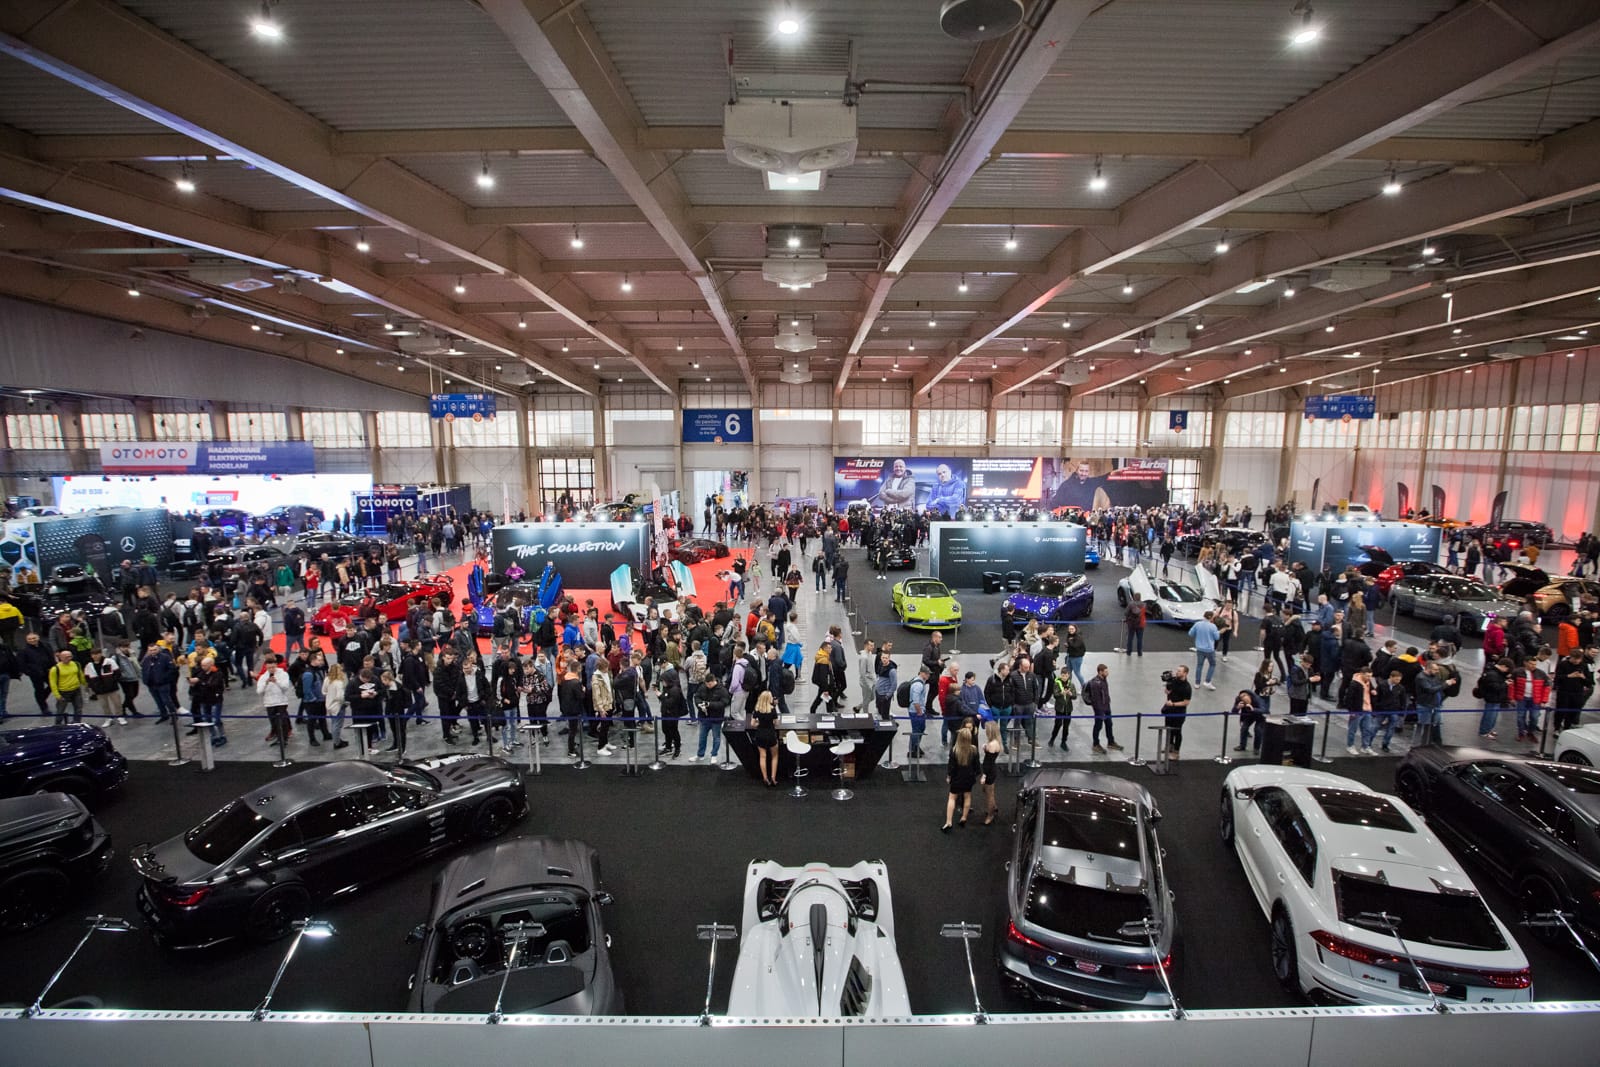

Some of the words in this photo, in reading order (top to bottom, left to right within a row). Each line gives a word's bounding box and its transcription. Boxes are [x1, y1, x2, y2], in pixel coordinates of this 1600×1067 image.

[725, 413, 741, 435] 6
[1175, 414, 1182, 423] 6
[112, 448, 189, 459] OTOMOTO
[359, 498, 414, 508] OTOMOTO
[547, 539, 625, 554] COLLECTION
